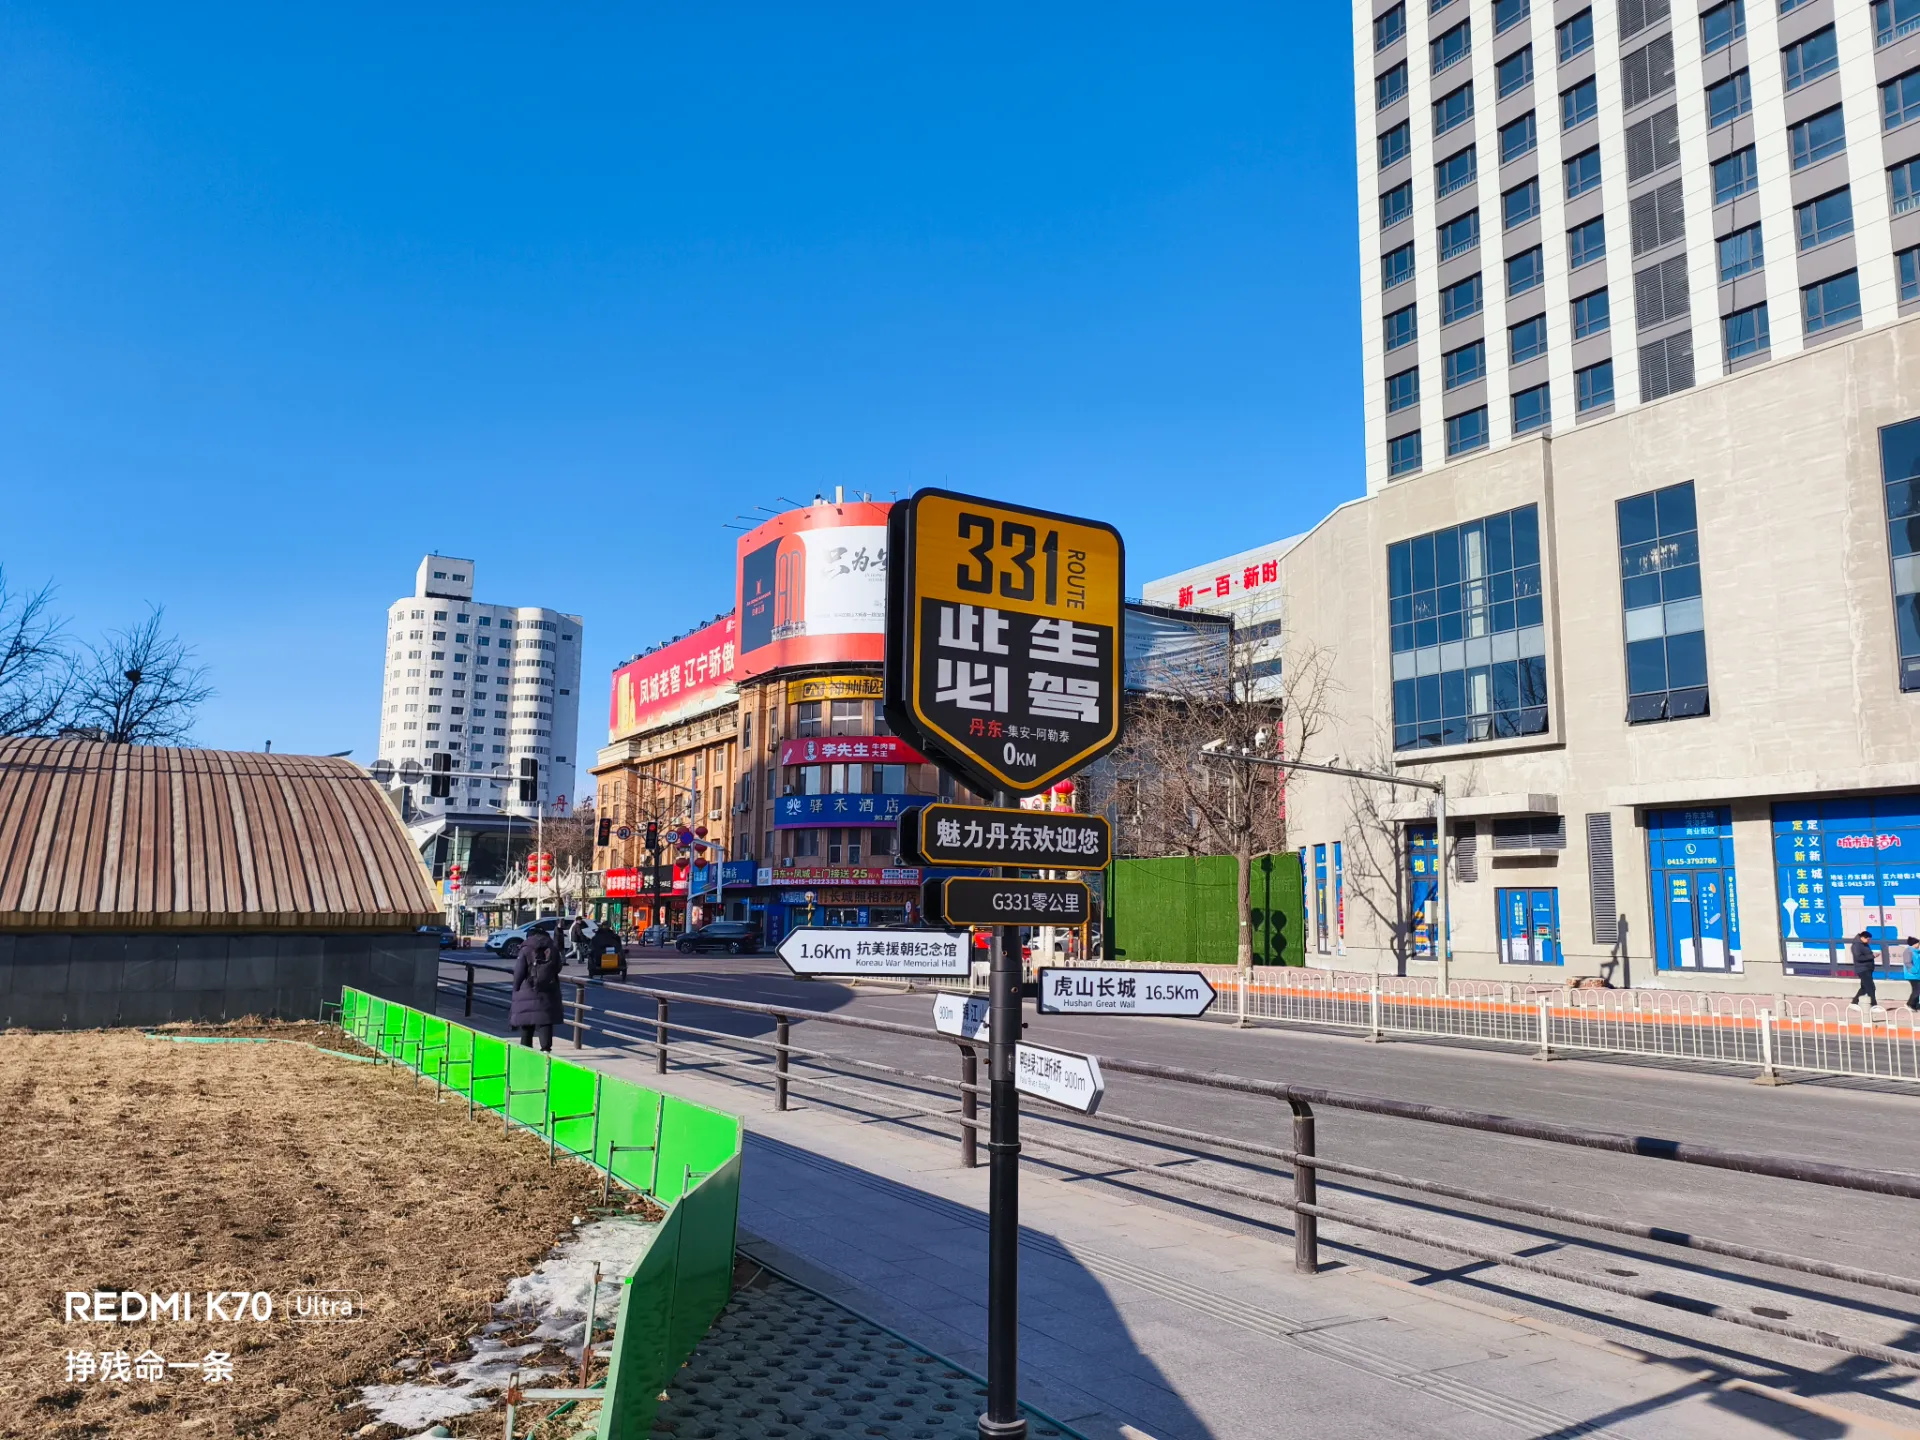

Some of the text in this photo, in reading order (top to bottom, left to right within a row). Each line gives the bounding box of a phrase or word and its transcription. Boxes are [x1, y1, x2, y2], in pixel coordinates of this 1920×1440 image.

[957, 512, 1058, 605] 331
[1066, 548, 1086, 610] ROUTE
[938, 602, 1100, 668] 此生
[639, 664, 682, 706] 凤城老窖
[829, 678, 884, 696] 神州租
[935, 658, 1100, 724] 必驾
[822, 742, 869, 758] 李先生
[872, 750, 888, 758] 大王
[809, 797, 900, 813] 驿禾酒店
[667, 832, 677, 841] 50
[936, 818, 1099, 854] 魅力丹东欢迎您
[852, 868, 868, 879] 25
[992, 892, 1080, 914] G331零公里
[800, 943, 851, 959] 1.6Km
[857, 941, 957, 957] 抗美援朝纪念馆
[885, 959, 901, 967] War
[903, 959, 939, 968] Memorial
[941, 960, 957, 968] Hall
[1053, 976, 1136, 998] 虎山长城
[1145, 984, 1199, 1000] 16.5Km
[1063, 999, 1136, 1009] Hushan Great Wall
[939, 1005, 954, 1020] 900m
[1064, 1069, 1086, 1092] 900m
